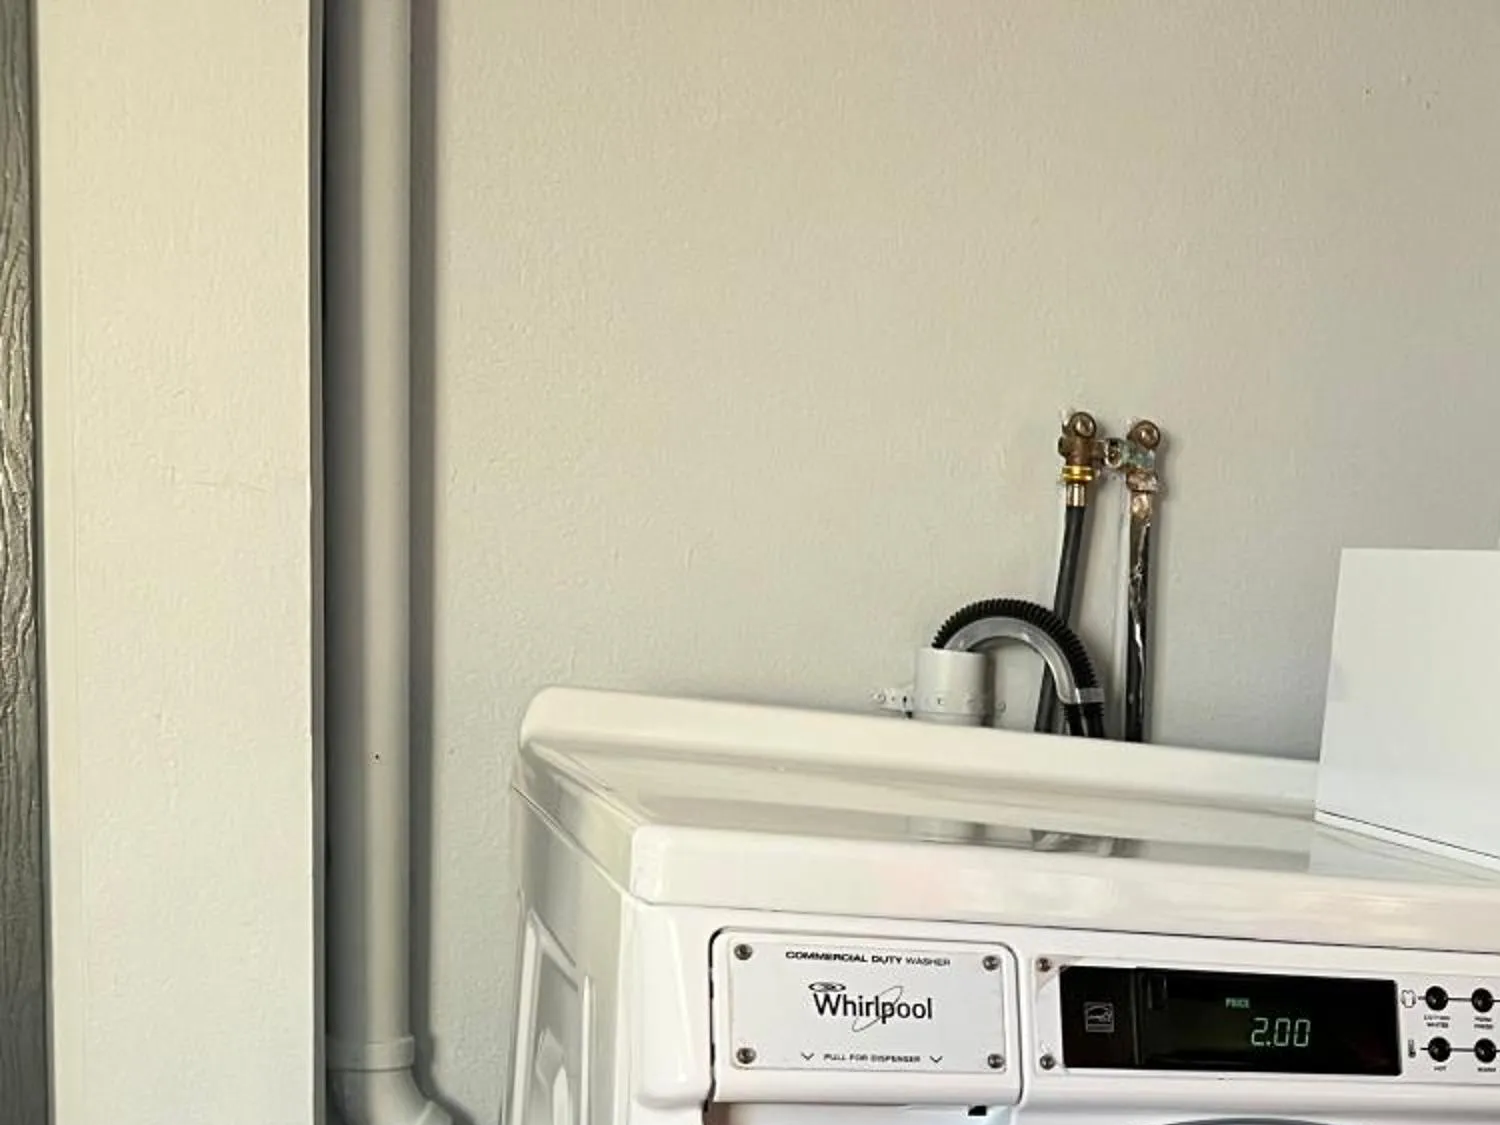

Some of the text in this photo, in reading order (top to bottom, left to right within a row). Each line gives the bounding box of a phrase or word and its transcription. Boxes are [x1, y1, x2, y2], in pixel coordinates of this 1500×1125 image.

[785, 951, 951, 967] COMMERCIAL DUTY WASHER
[813, 993, 933, 1024] Whirlpool
[1251, 1017, 1311, 1047] 2.00
